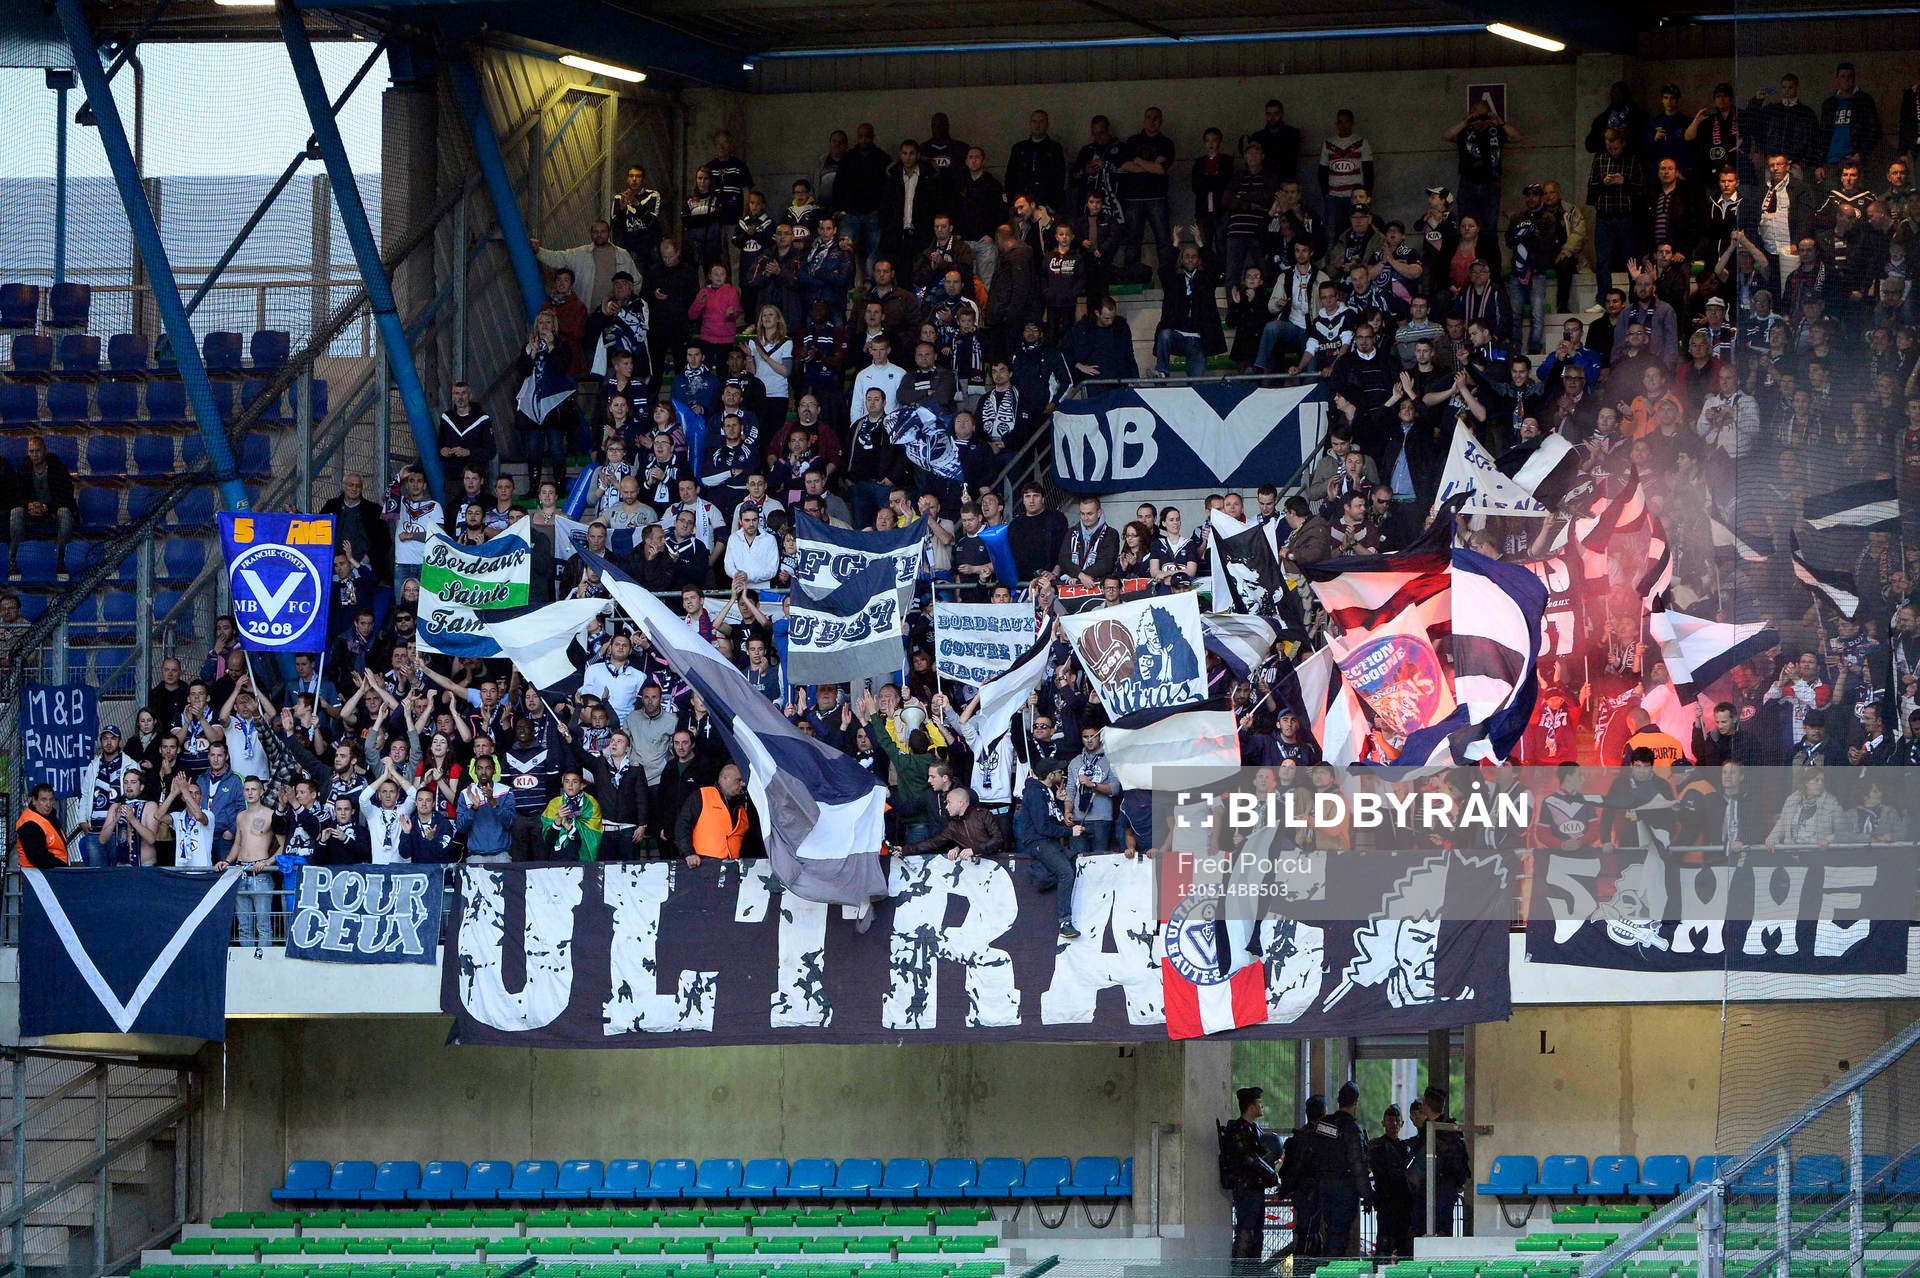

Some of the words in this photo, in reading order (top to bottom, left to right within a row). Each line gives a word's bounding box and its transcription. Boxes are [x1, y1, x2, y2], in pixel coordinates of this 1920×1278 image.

[1052, 406, 1159, 482] MB
[234, 518, 254, 543] 5
[286, 520, 332, 545] ANS
[426, 545, 525, 574] Bordeaux
[439, 580, 510, 605] Sainté
[234, 600, 257, 612] MB
[288, 601, 311, 613] FC
[249, 621, 292, 635] 2008
[428, 609, 487, 633] Fam
[937, 615, 1034, 632] BORDEAUX
[940, 638, 1011, 661] CONTRE
[516, 777, 535, 786] KIA
[1563, 823, 1582, 831] KIA
[298, 866, 429, 915] POUR
[291, 908, 428, 955] CEUX
